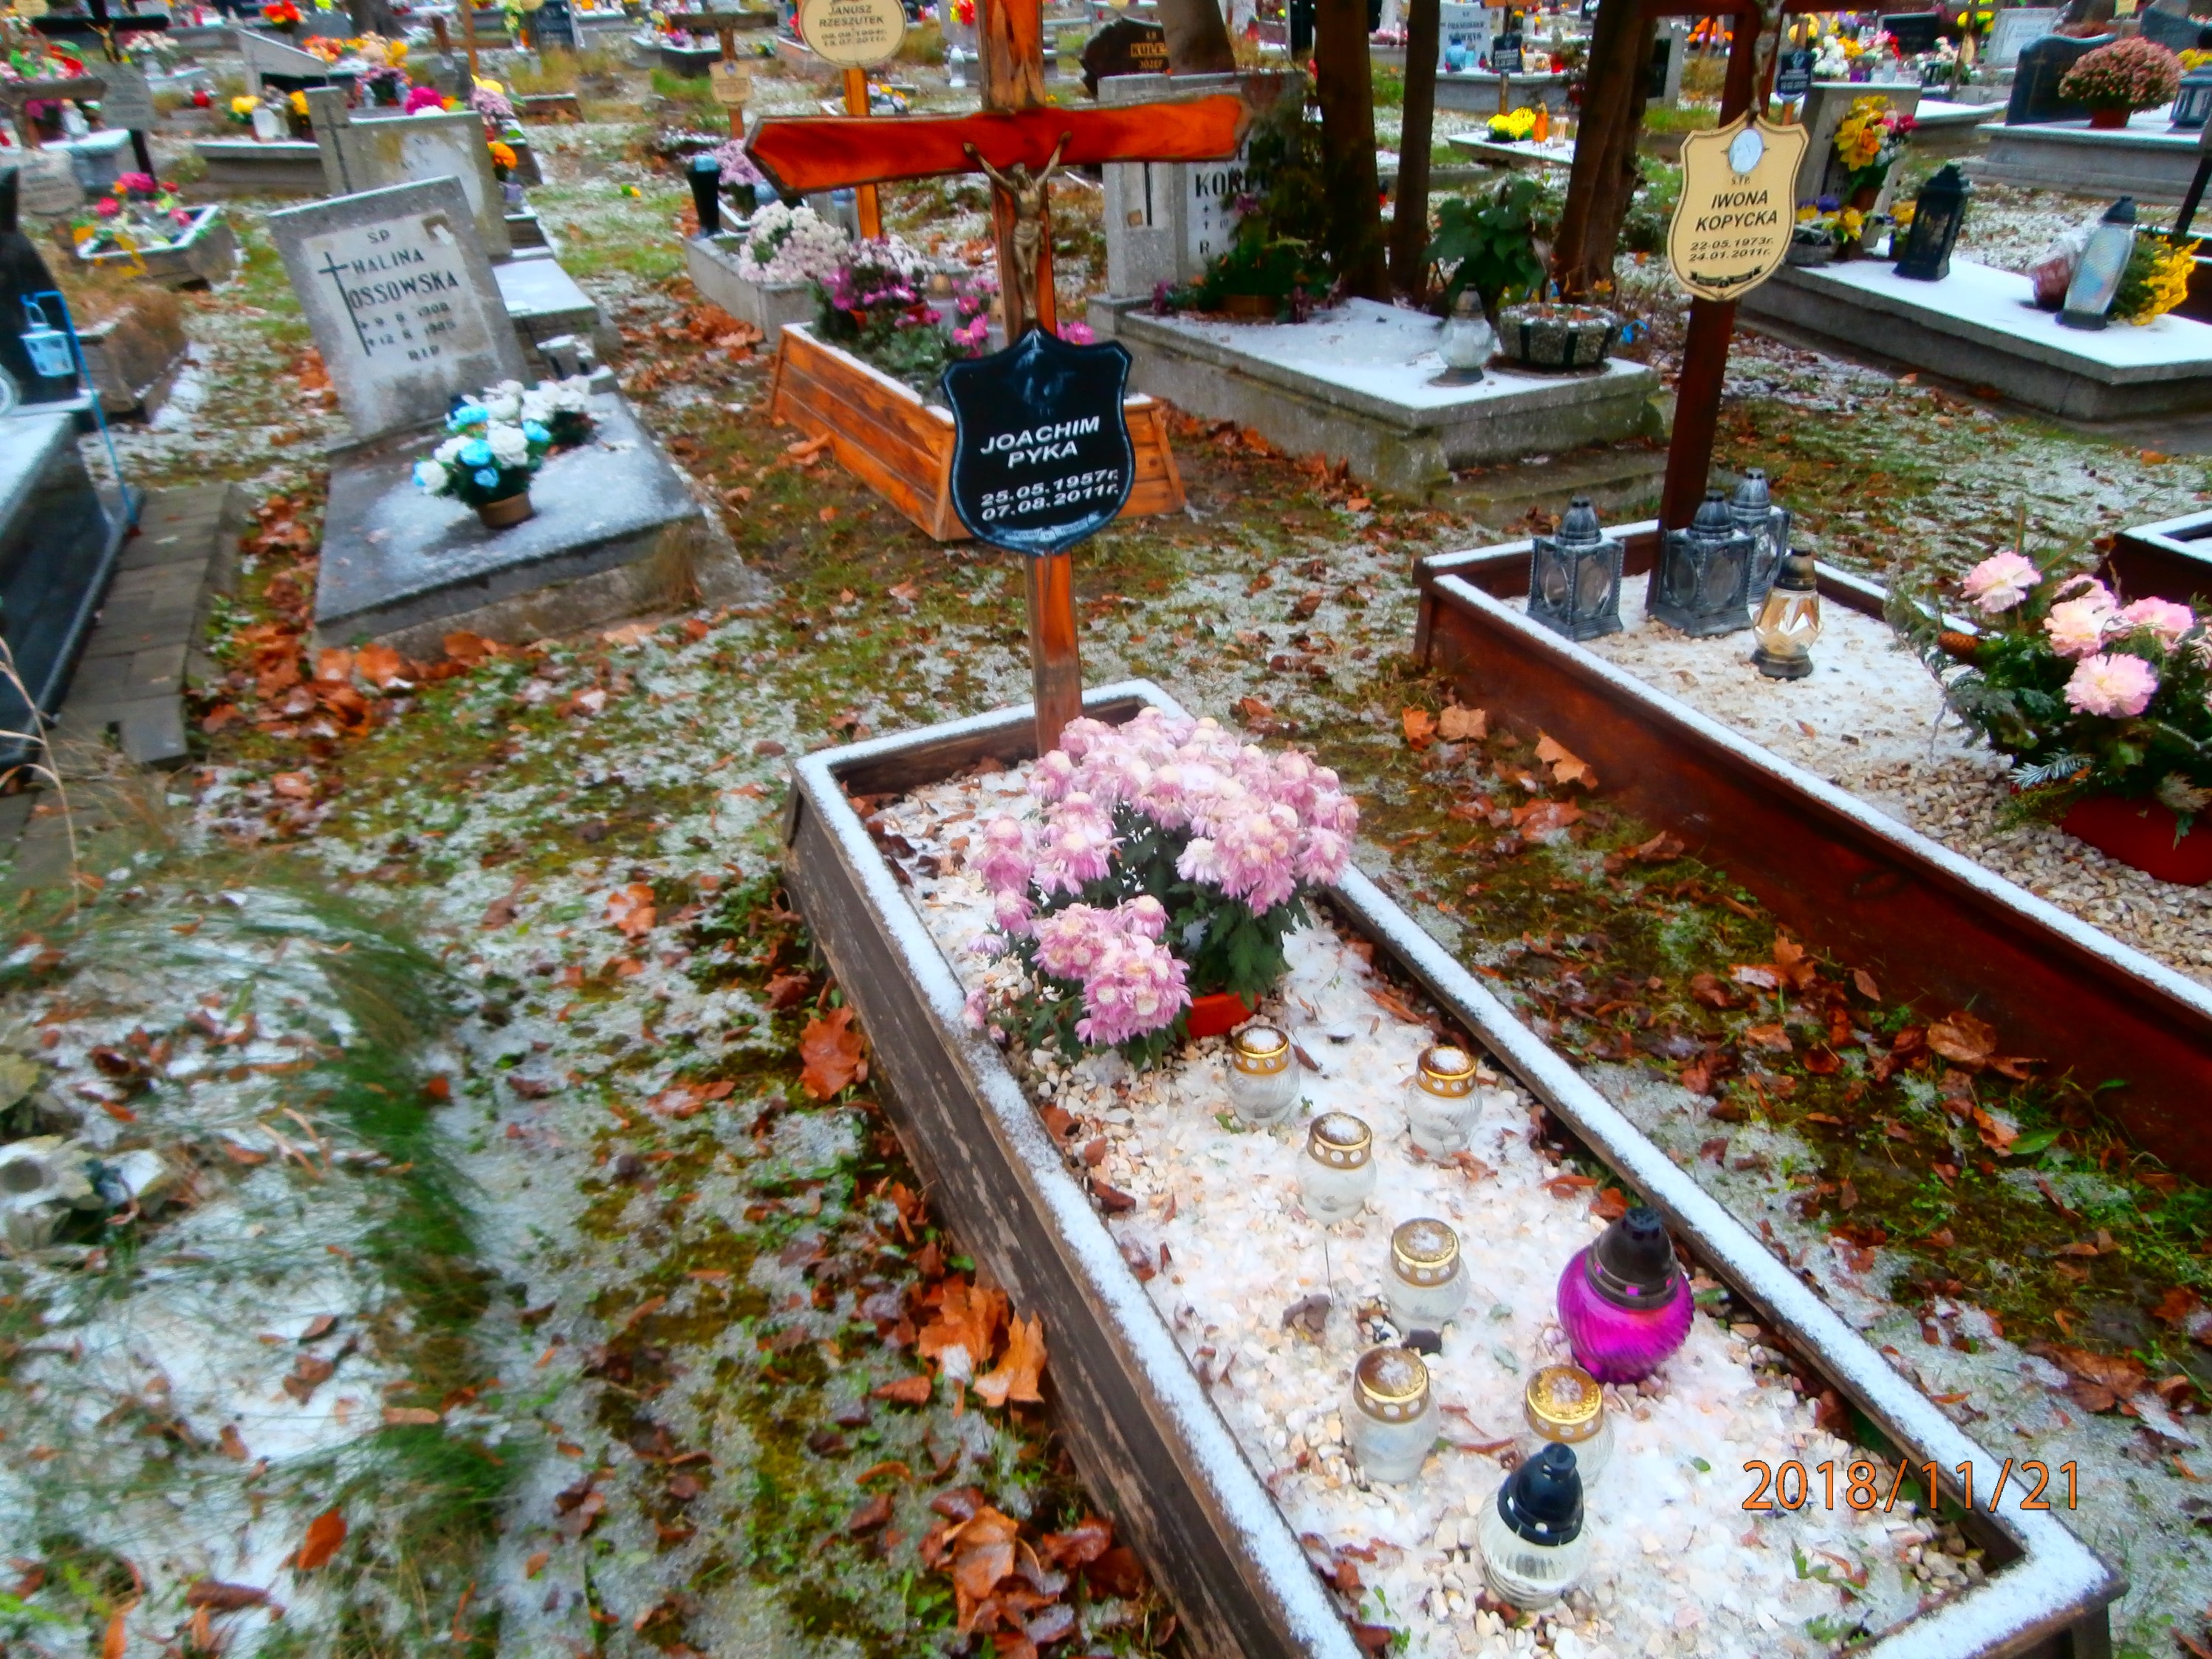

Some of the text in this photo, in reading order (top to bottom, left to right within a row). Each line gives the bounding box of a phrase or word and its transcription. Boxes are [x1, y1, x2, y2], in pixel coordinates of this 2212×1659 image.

[819, 16, 884, 27] RZESZUTEK
[828, 5, 872, 16] JANUSZ
[1711, 190, 1768, 209] IWONA
[1695, 210, 1778, 232] KOPYCKA
[351, 248, 425, 274] HALINA
[348, 270, 459, 309] OSSOWSKA
[980, 415, 1100, 455] JOACHIM
[1007, 440, 1078, 469] PYKA
[981, 469, 1119, 507] 25.05.1957r.
[982, 483, 1120, 521] 07.08.2011r.
